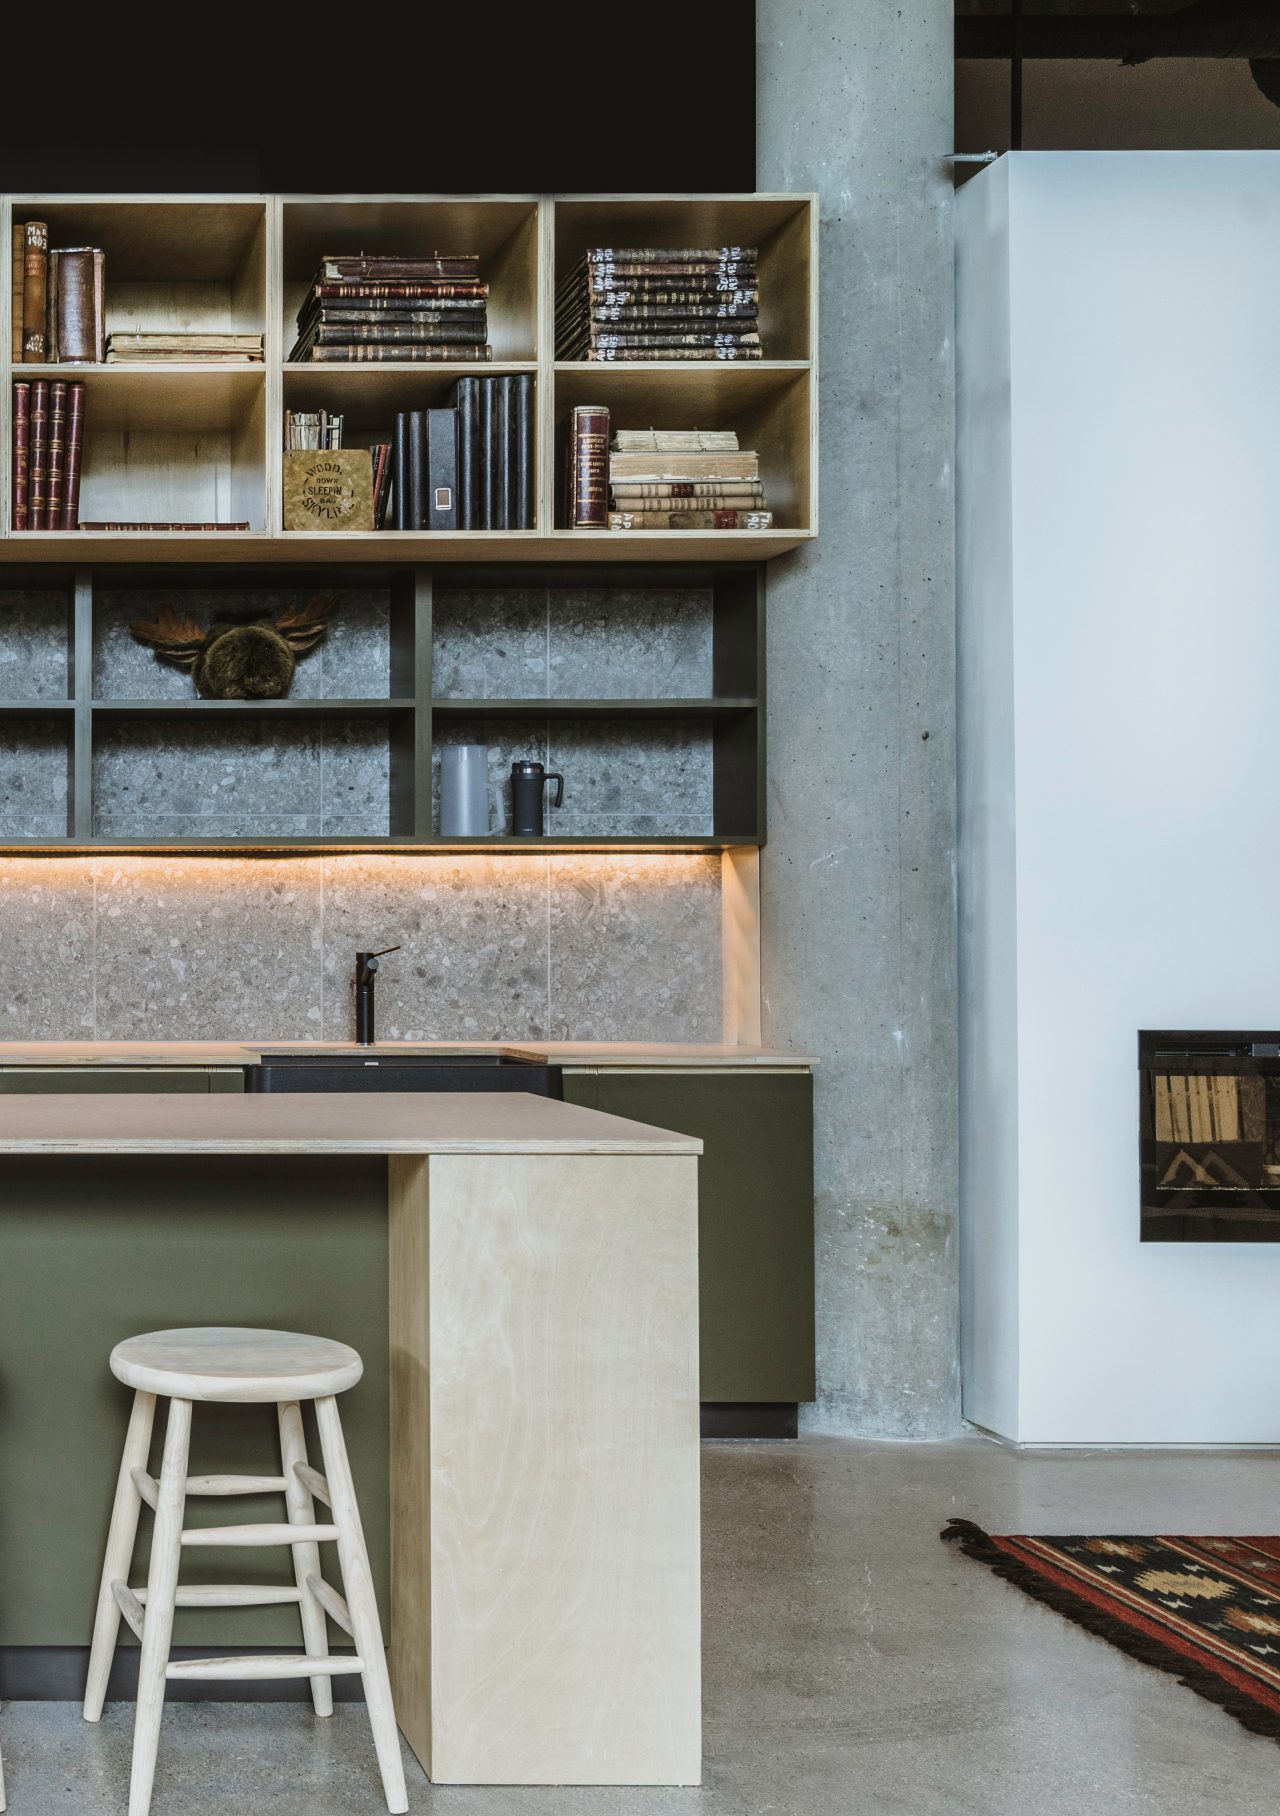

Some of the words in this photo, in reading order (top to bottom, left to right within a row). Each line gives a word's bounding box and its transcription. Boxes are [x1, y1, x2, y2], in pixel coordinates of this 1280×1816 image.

[28, 235, 47, 250] 1903
[305, 462, 342, 477] WOOD
[308, 486, 345, 496] SLEEPIN
[302, 497, 354, 519] SKYLI
